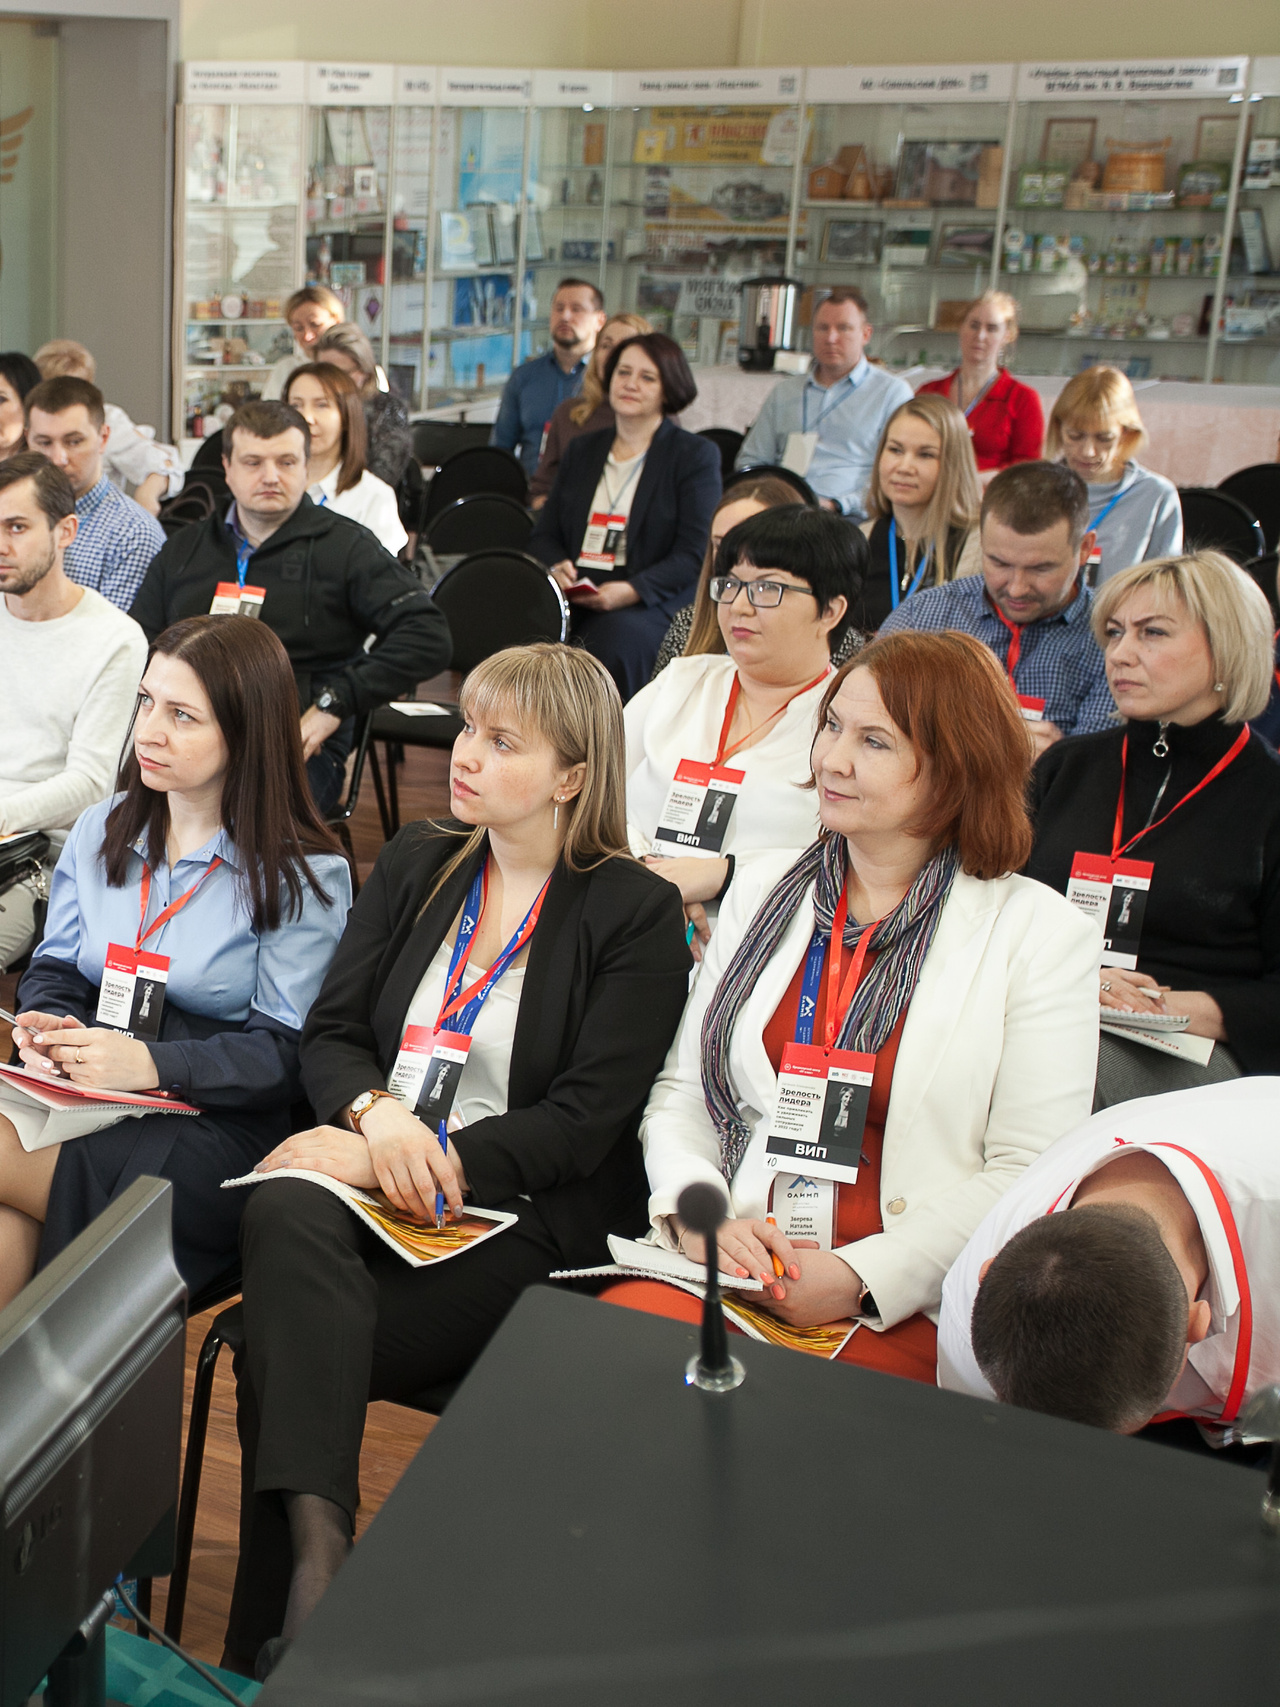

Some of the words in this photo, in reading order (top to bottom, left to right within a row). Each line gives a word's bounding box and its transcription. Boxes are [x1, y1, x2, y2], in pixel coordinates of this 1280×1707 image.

[676, 833, 700, 846] ВИП
[1072, 891, 1107, 901] Зрелость
[1071, 898, 1098, 907] лидера
[105, 980, 131, 992] Зрелость
[104, 988, 125, 998] лидера
[780, 1087, 821, 1100] Зрелость
[779, 1097, 811, 1107] лидера
[795, 1143, 827, 1159] ВИП
